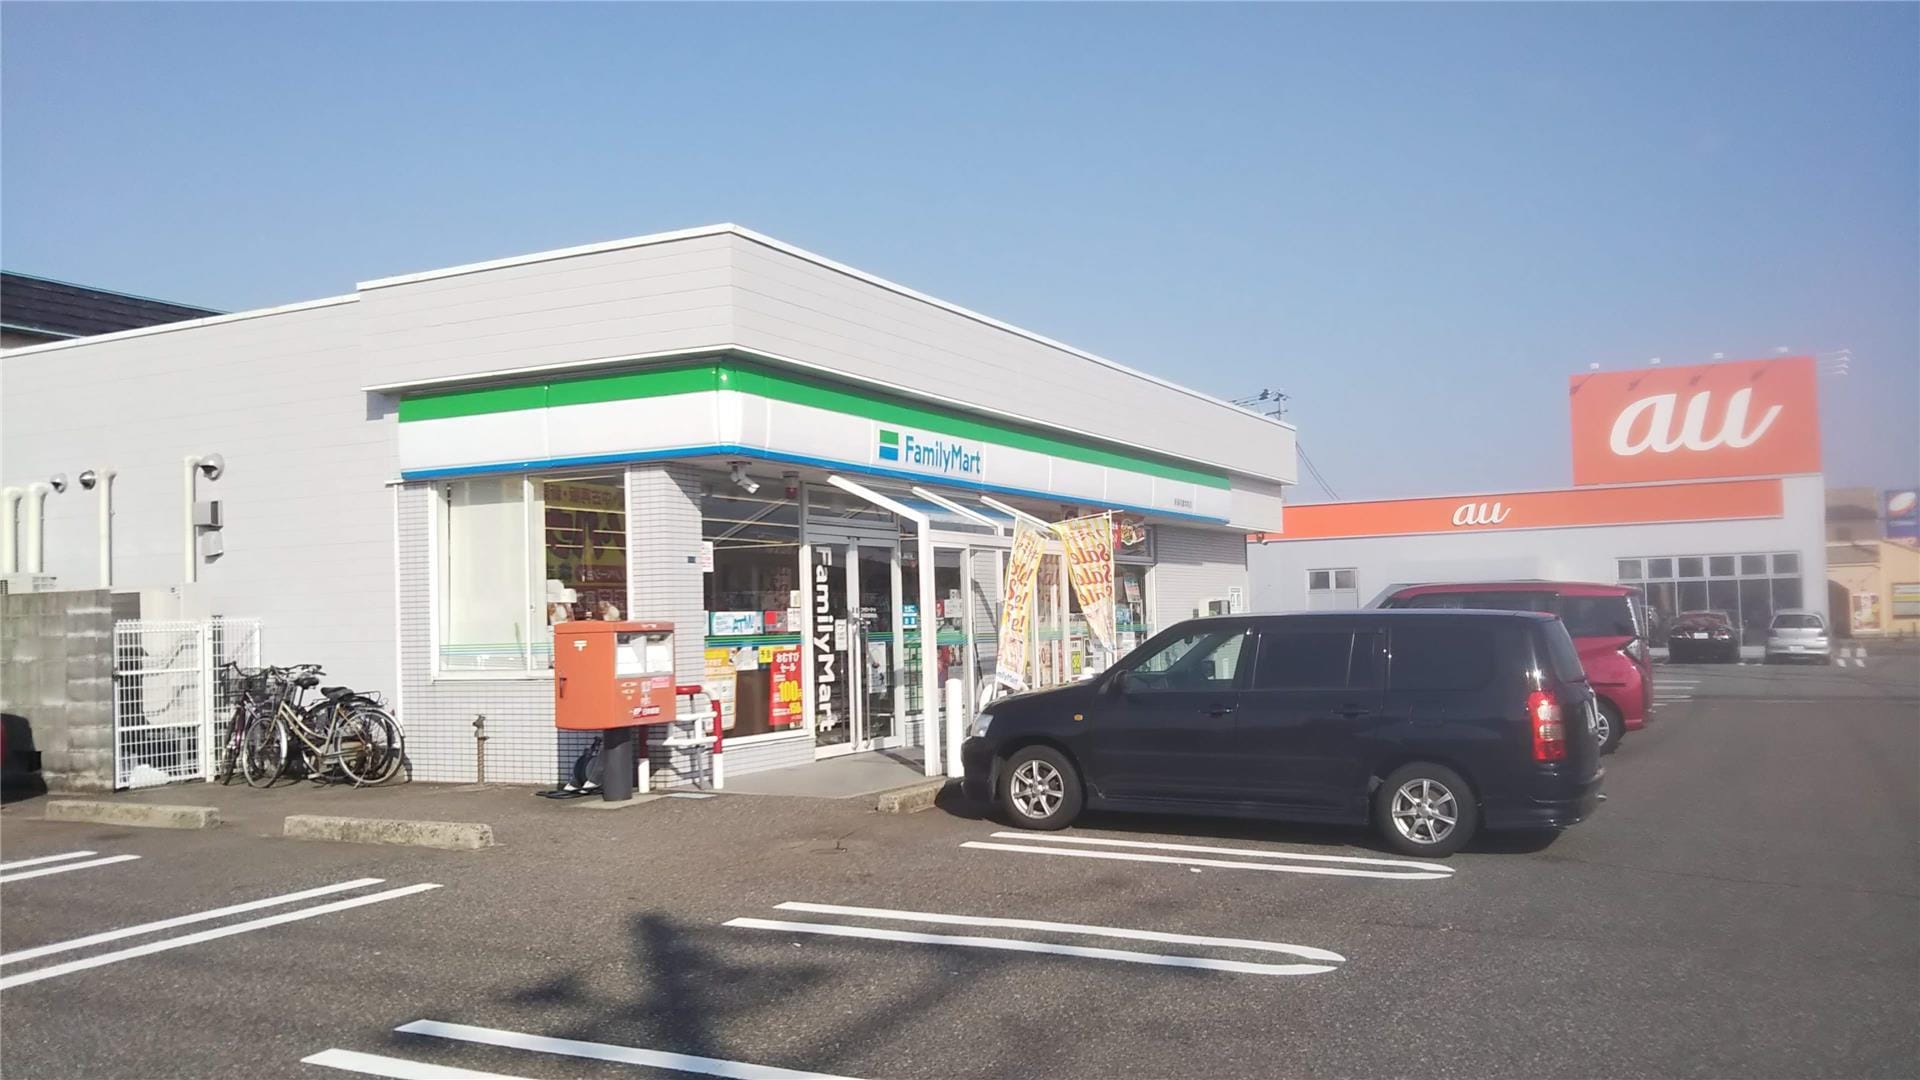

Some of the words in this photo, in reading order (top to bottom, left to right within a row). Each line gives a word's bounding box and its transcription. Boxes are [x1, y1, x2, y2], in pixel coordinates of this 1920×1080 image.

[1609, 387, 1784, 456] au
[904, 434, 981, 474] FamilyMart
[1452, 501, 1511, 525] au
[814, 546, 836, 733] FamilyMart
